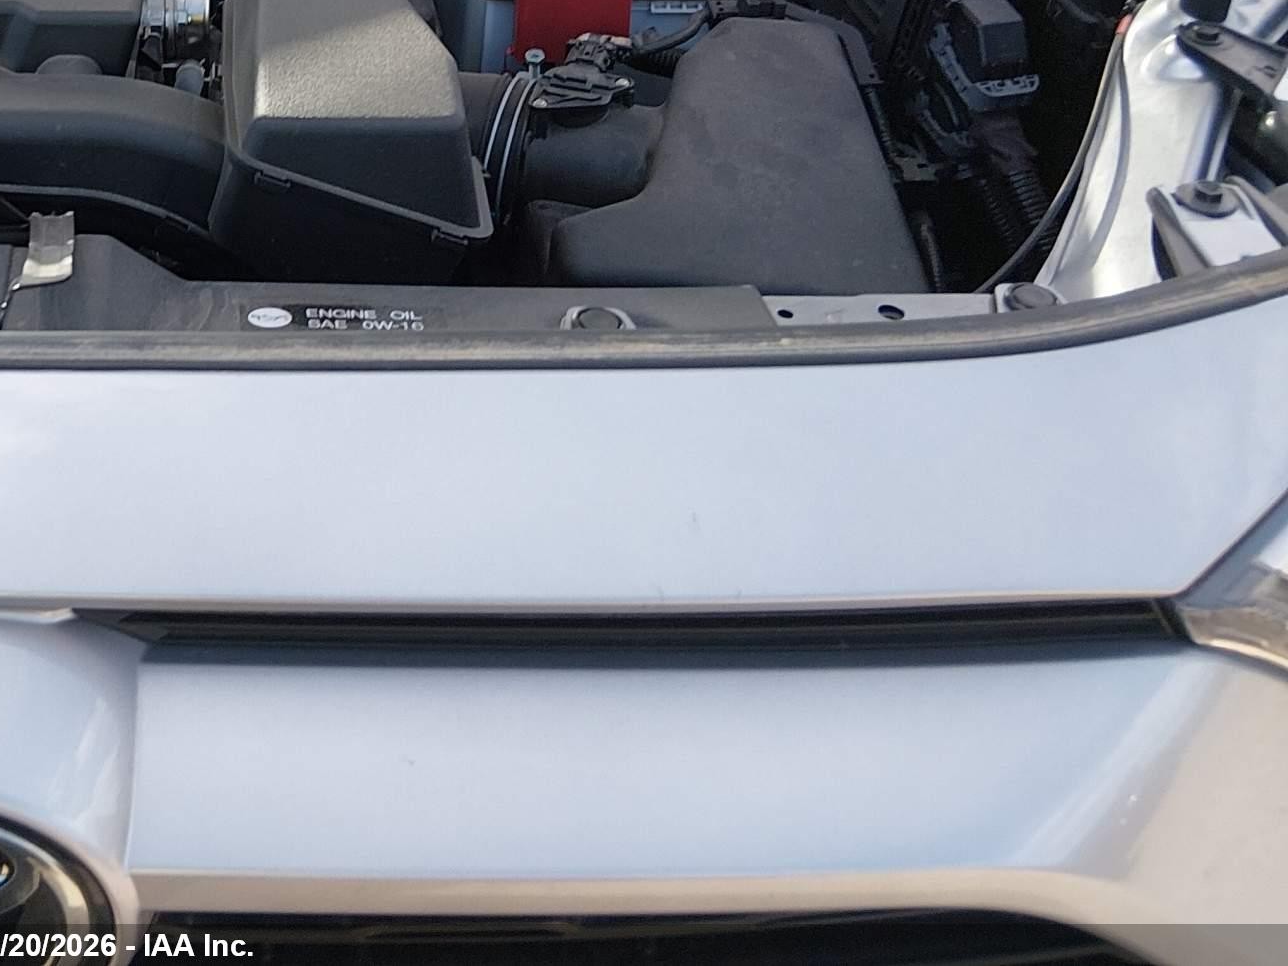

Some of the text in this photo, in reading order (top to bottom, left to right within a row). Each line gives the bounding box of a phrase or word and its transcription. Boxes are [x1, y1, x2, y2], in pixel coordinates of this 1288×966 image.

[305, 307, 424, 321] ENGINE OIL
[307, 319, 349, 331] SAE
